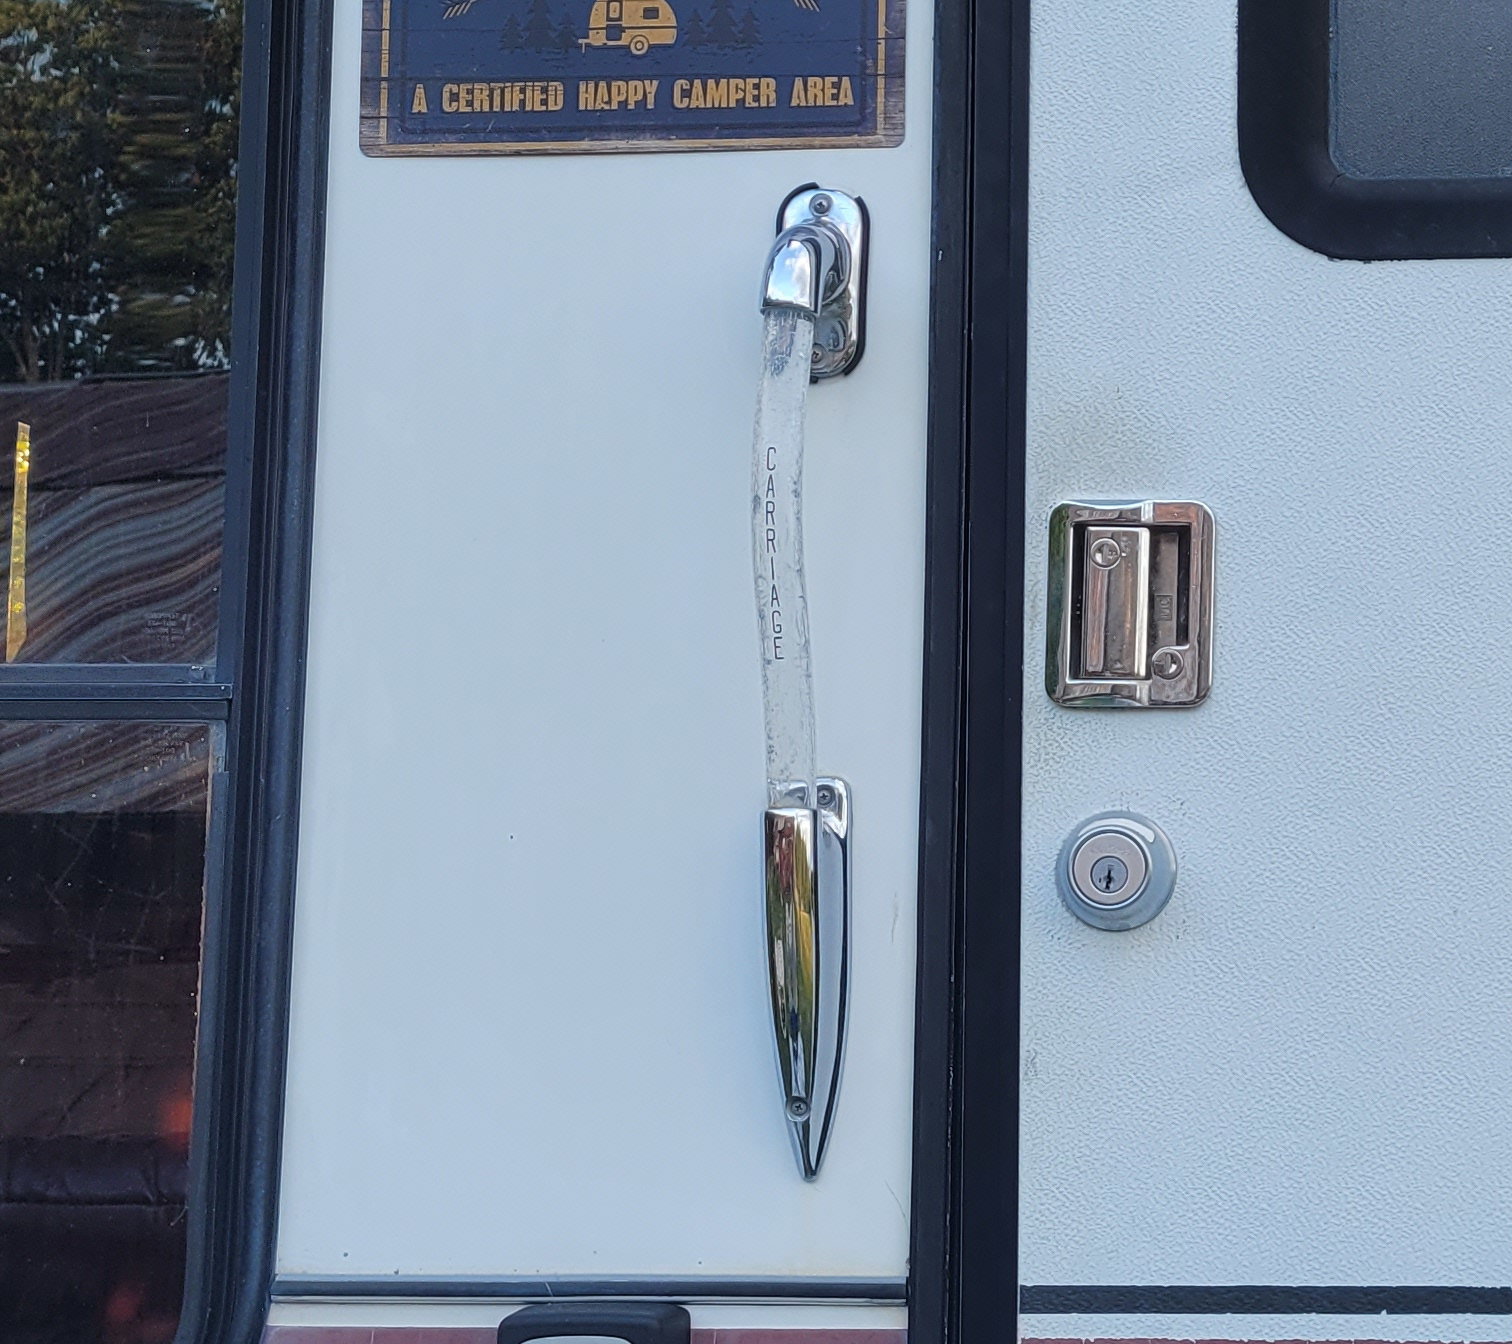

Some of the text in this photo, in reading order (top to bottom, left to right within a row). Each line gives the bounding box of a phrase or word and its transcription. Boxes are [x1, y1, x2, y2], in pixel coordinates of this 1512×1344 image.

[411, 76, 855, 113] A CERTIFIED HAPPY CAMPER AREA
[765, 446, 785, 661] CARRIAGE
